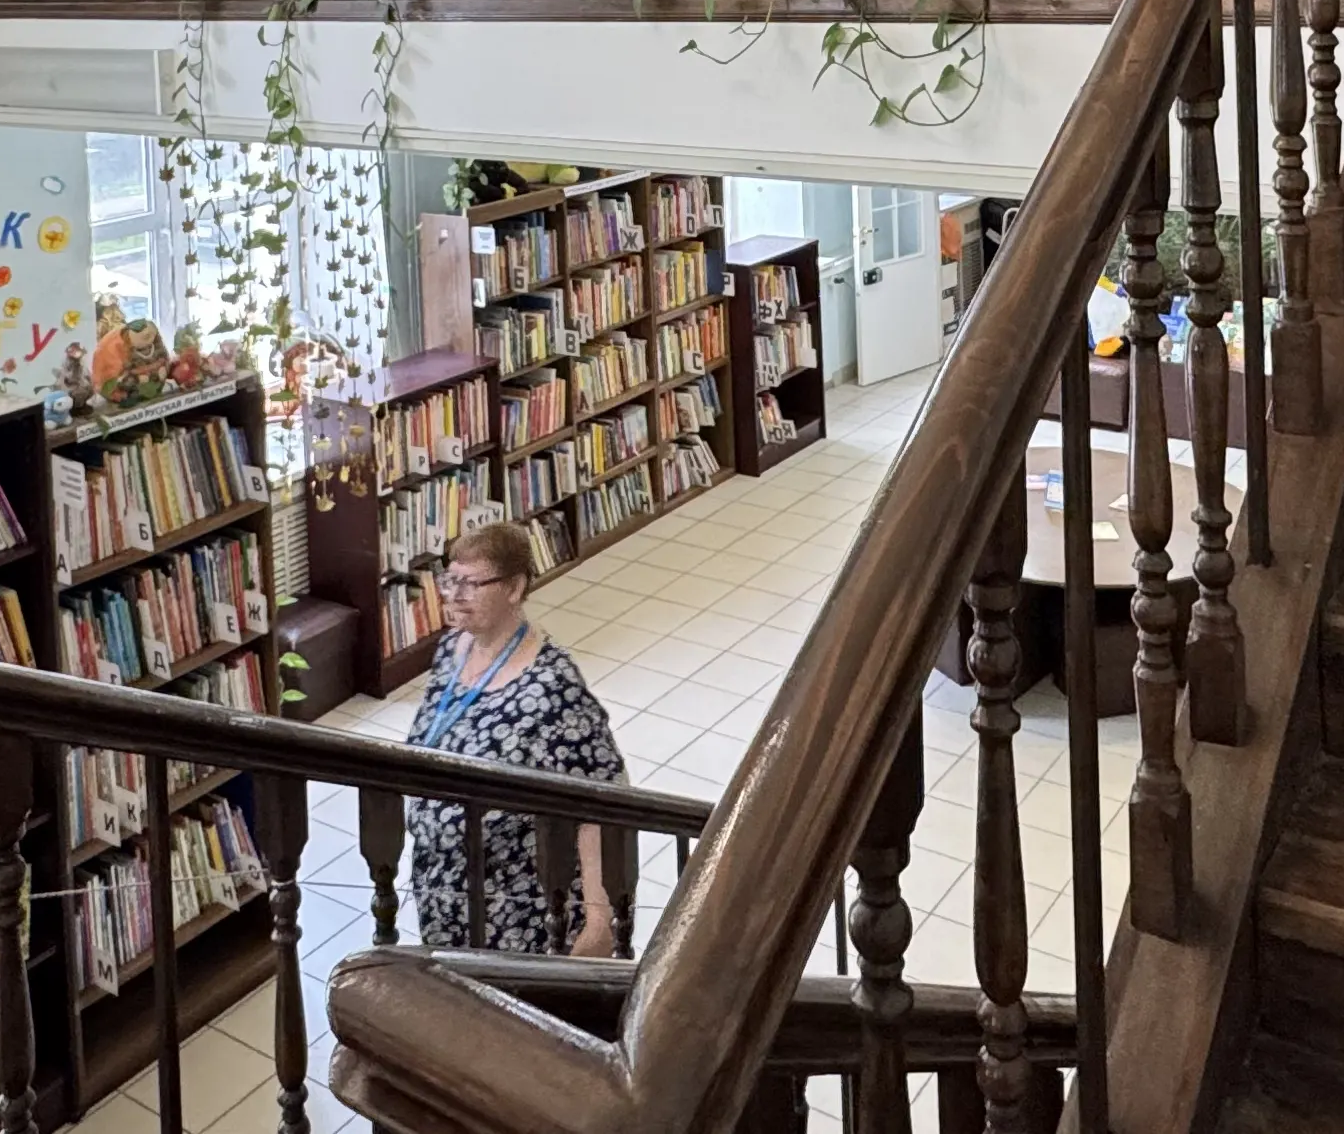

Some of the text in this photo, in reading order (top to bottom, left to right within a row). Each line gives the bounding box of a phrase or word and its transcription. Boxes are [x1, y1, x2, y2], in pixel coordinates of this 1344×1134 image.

[712, 207, 723, 225] П
[620, 227, 639, 250] Ж
[513, 268, 525, 290] Б
[774, 299, 784, 316] Х
[565, 333, 576, 353] В
[692, 352, 703, 370] С
[78, 412, 144, 438] ДОШЛЬНАЯ
[452, 445, 460, 457] С
[250, 476, 263, 492] В
[138, 523, 149, 541] Б
[57, 553, 68, 573] А
[247, 601, 262, 622] Ж
[226, 615, 236, 634] Е
[154, 650, 167, 673] Д
[126, 801, 137, 823] К
[103, 813, 116, 835] И
[221, 883, 234, 901] Н
[97, 959, 114, 984] М
